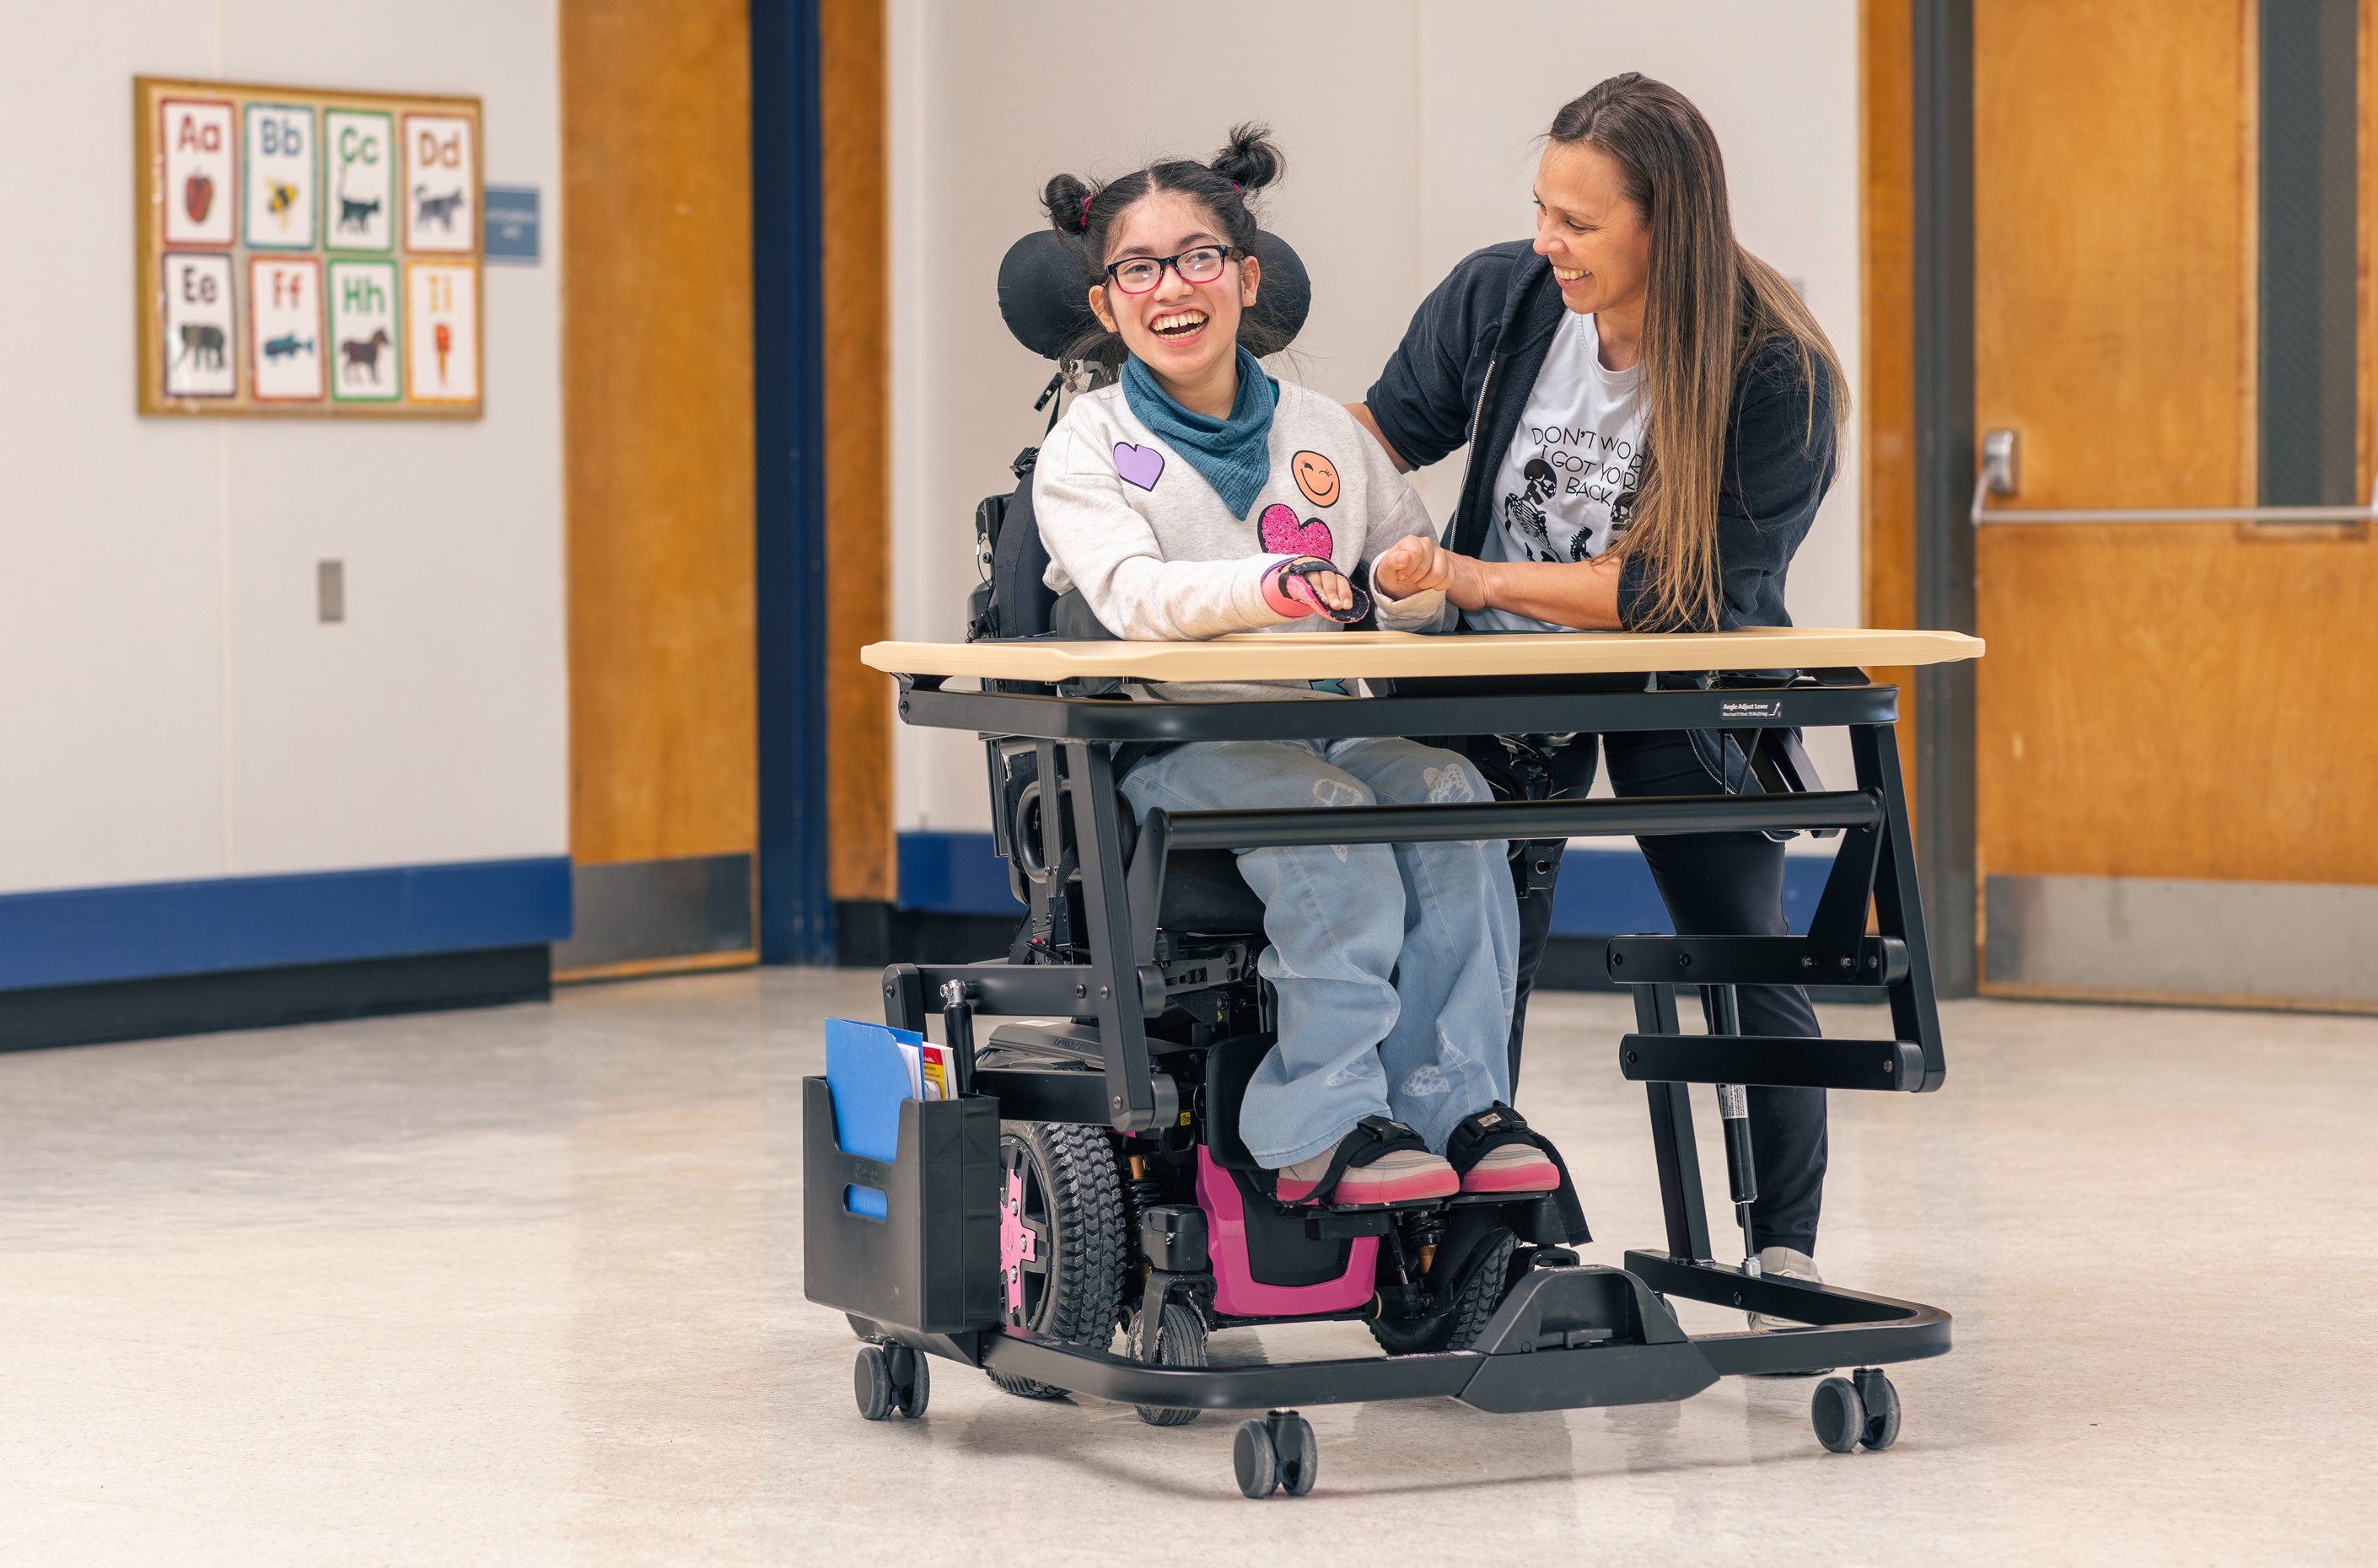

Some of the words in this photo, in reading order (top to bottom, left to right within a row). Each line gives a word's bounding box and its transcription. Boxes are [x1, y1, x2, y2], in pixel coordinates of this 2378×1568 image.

[177, 114, 223, 154] Aa
[261, 118, 303, 158] Bb
[339, 126, 380, 165] Cc
[418, 131, 461, 169] Dd
[181, 266, 218, 306] Ee
[272, 269, 304, 309] Ff
[342, 275, 386, 315] Hh
[428, 274, 453, 314] Ii
[1531, 427, 1596, 449] DON'T
[1601, 437, 1643, 474] WOR
[1540, 444, 1549, 459] I
[1551, 450, 1598, 475] GOT
[1565, 477, 1613, 507] BACK
